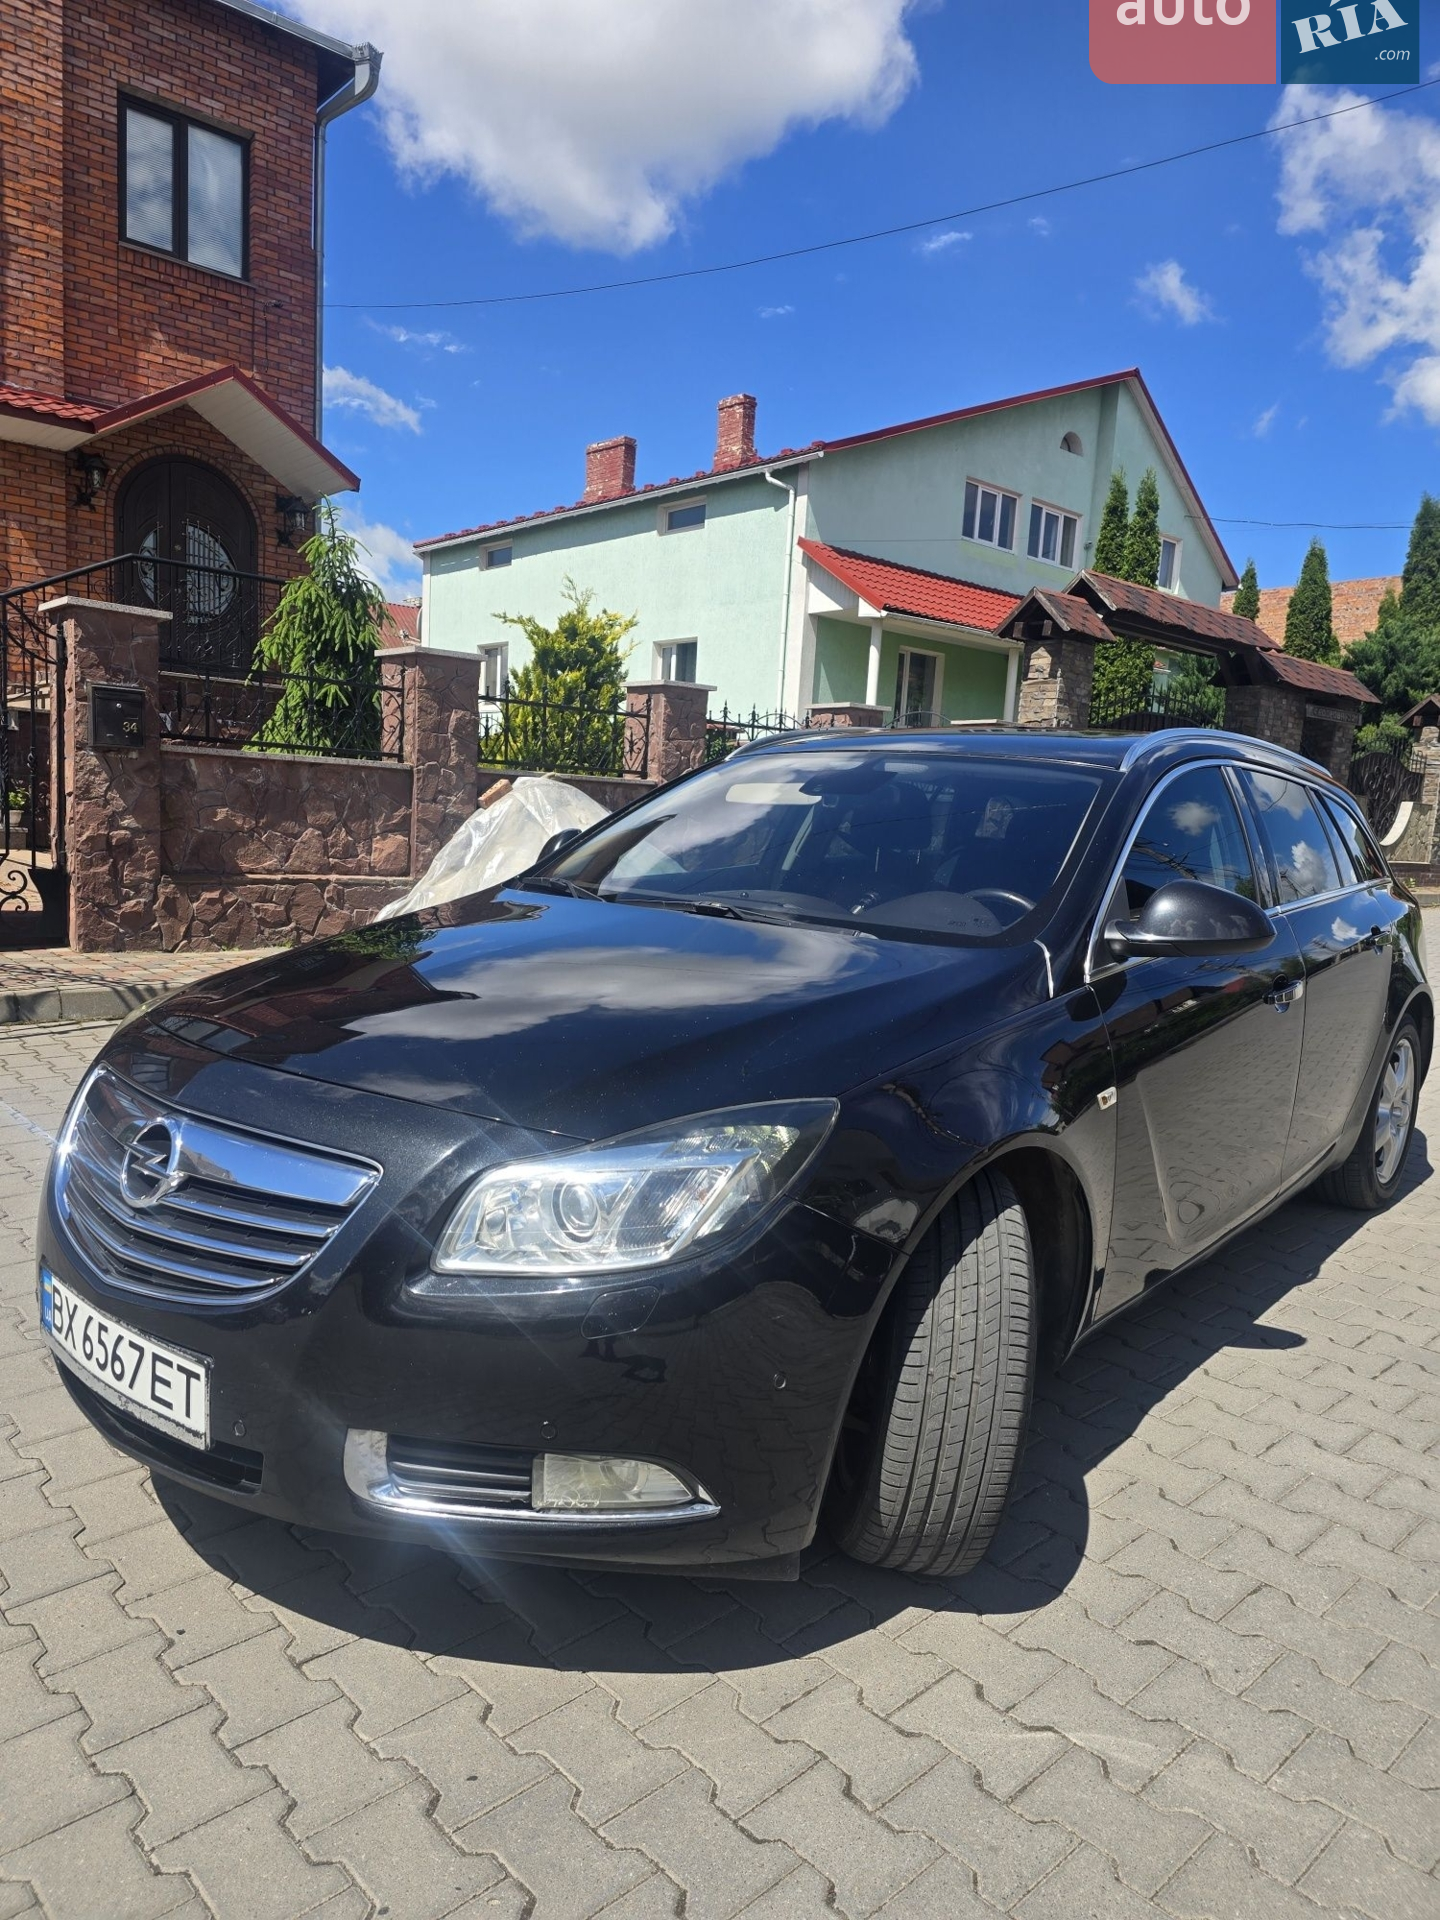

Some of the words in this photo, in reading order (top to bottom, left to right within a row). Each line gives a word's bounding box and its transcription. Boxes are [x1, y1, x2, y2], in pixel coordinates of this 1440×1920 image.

[123, 722, 138, 733] 34
[52, 1284, 78, 1350] BX
[82, 1315, 145, 1390] 6567
[151, 1352, 201, 1419] ET
